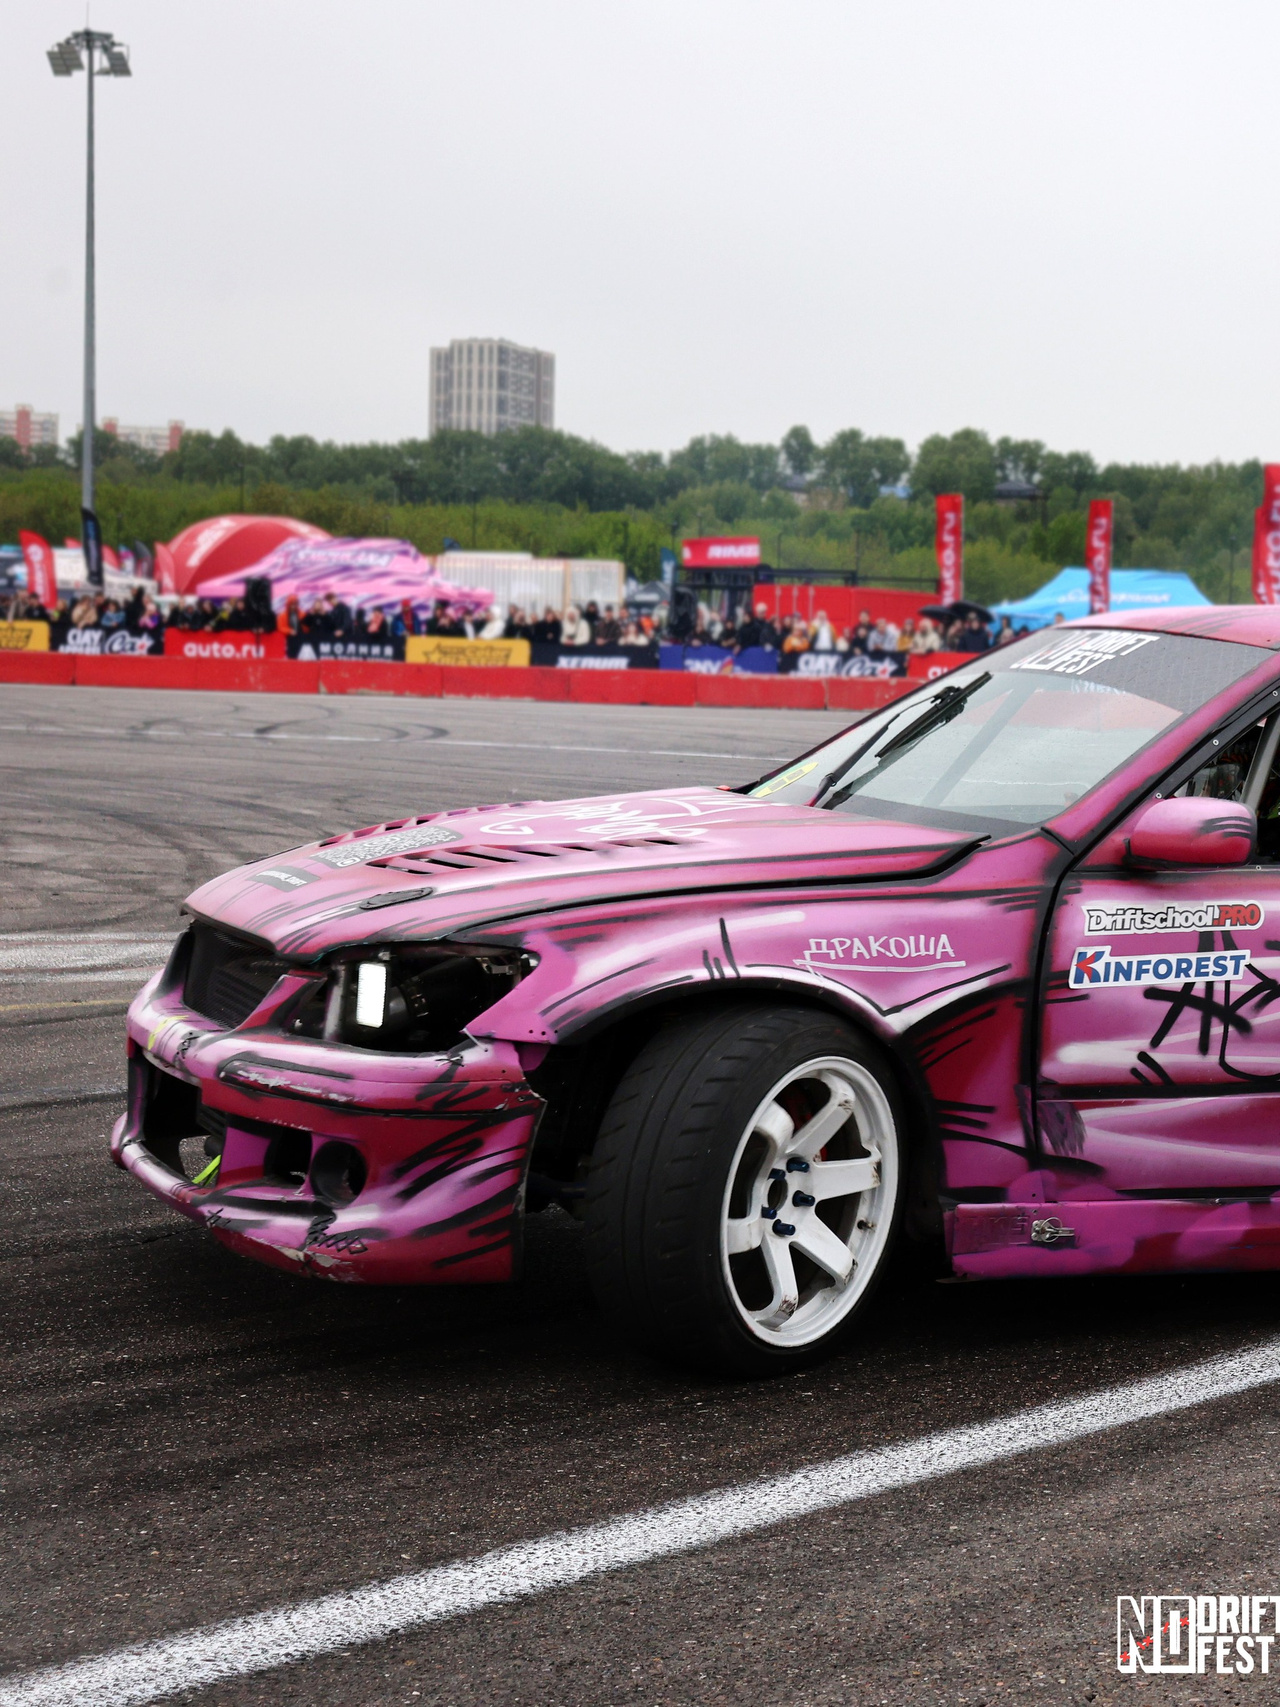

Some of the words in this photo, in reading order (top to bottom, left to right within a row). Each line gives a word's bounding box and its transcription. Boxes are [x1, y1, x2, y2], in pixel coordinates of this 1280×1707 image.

[183, 643, 265, 658] auto.ru
[1087, 903, 1262, 932] Driftschool.PRO
[803, 934, 956, 961] ДРАКОША
[1073, 951, 1246, 984] KINFOREST
